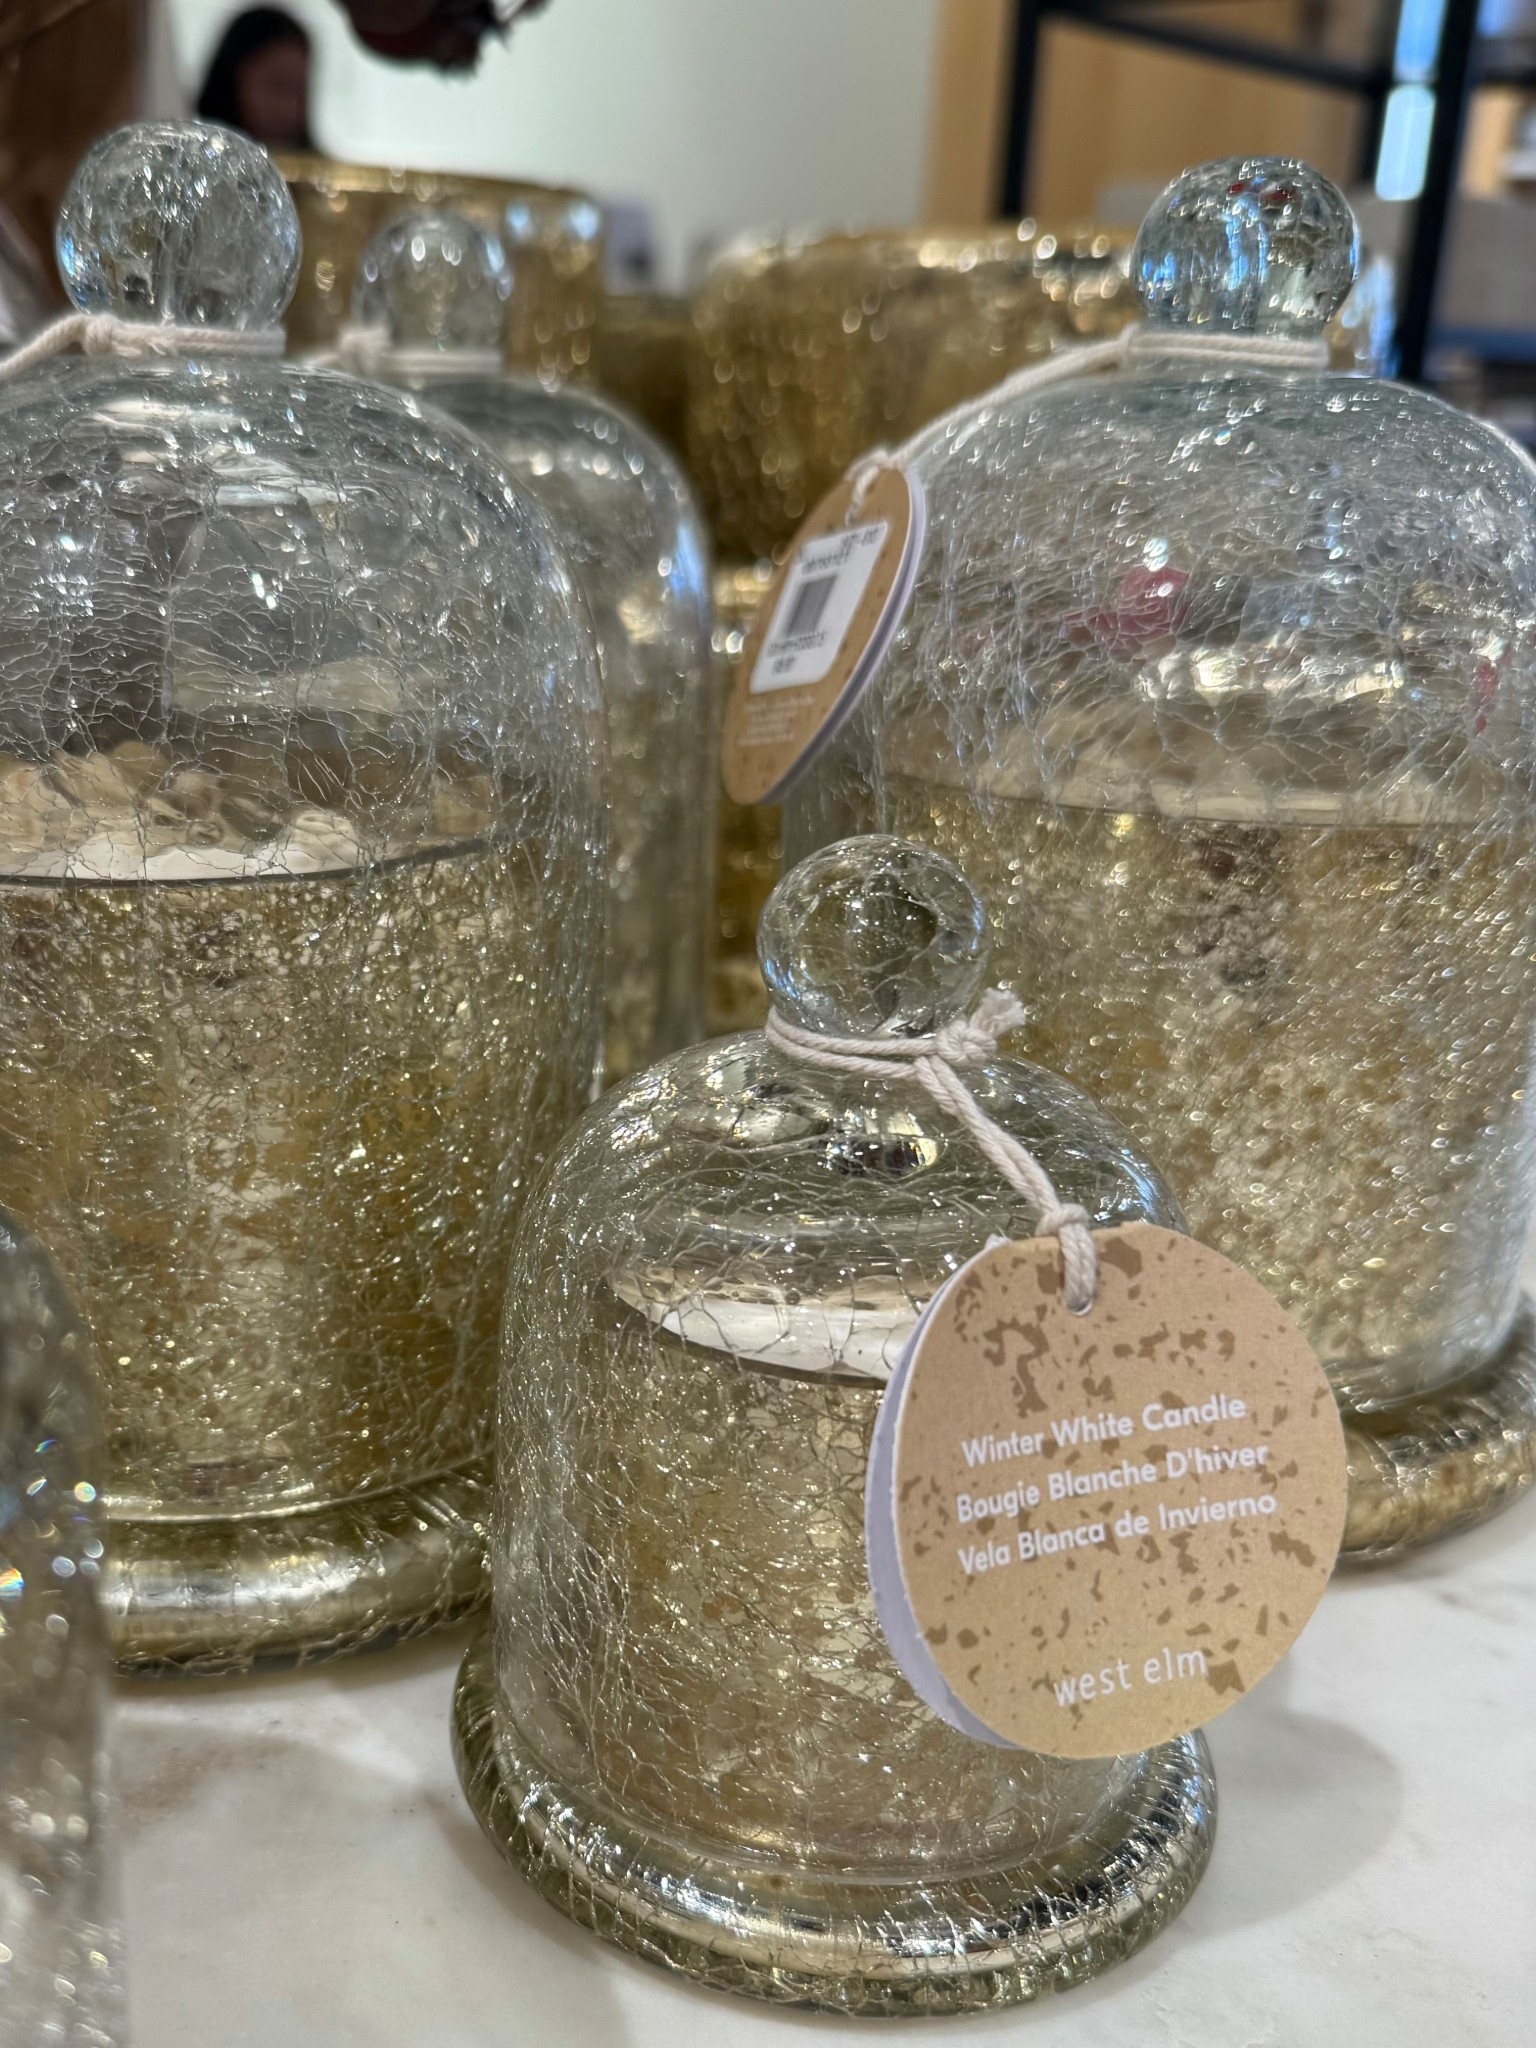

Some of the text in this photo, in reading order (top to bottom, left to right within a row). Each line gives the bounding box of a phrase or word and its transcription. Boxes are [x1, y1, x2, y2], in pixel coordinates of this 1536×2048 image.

[961, 1394, 1246, 1468] Winter White Candle
[956, 1443, 1268, 1523] Bougie Blanche D'hiver
[957, 1495, 1277, 1575] Vela Blanca de Invierno
[1053, 1647, 1207, 1706] west elm
